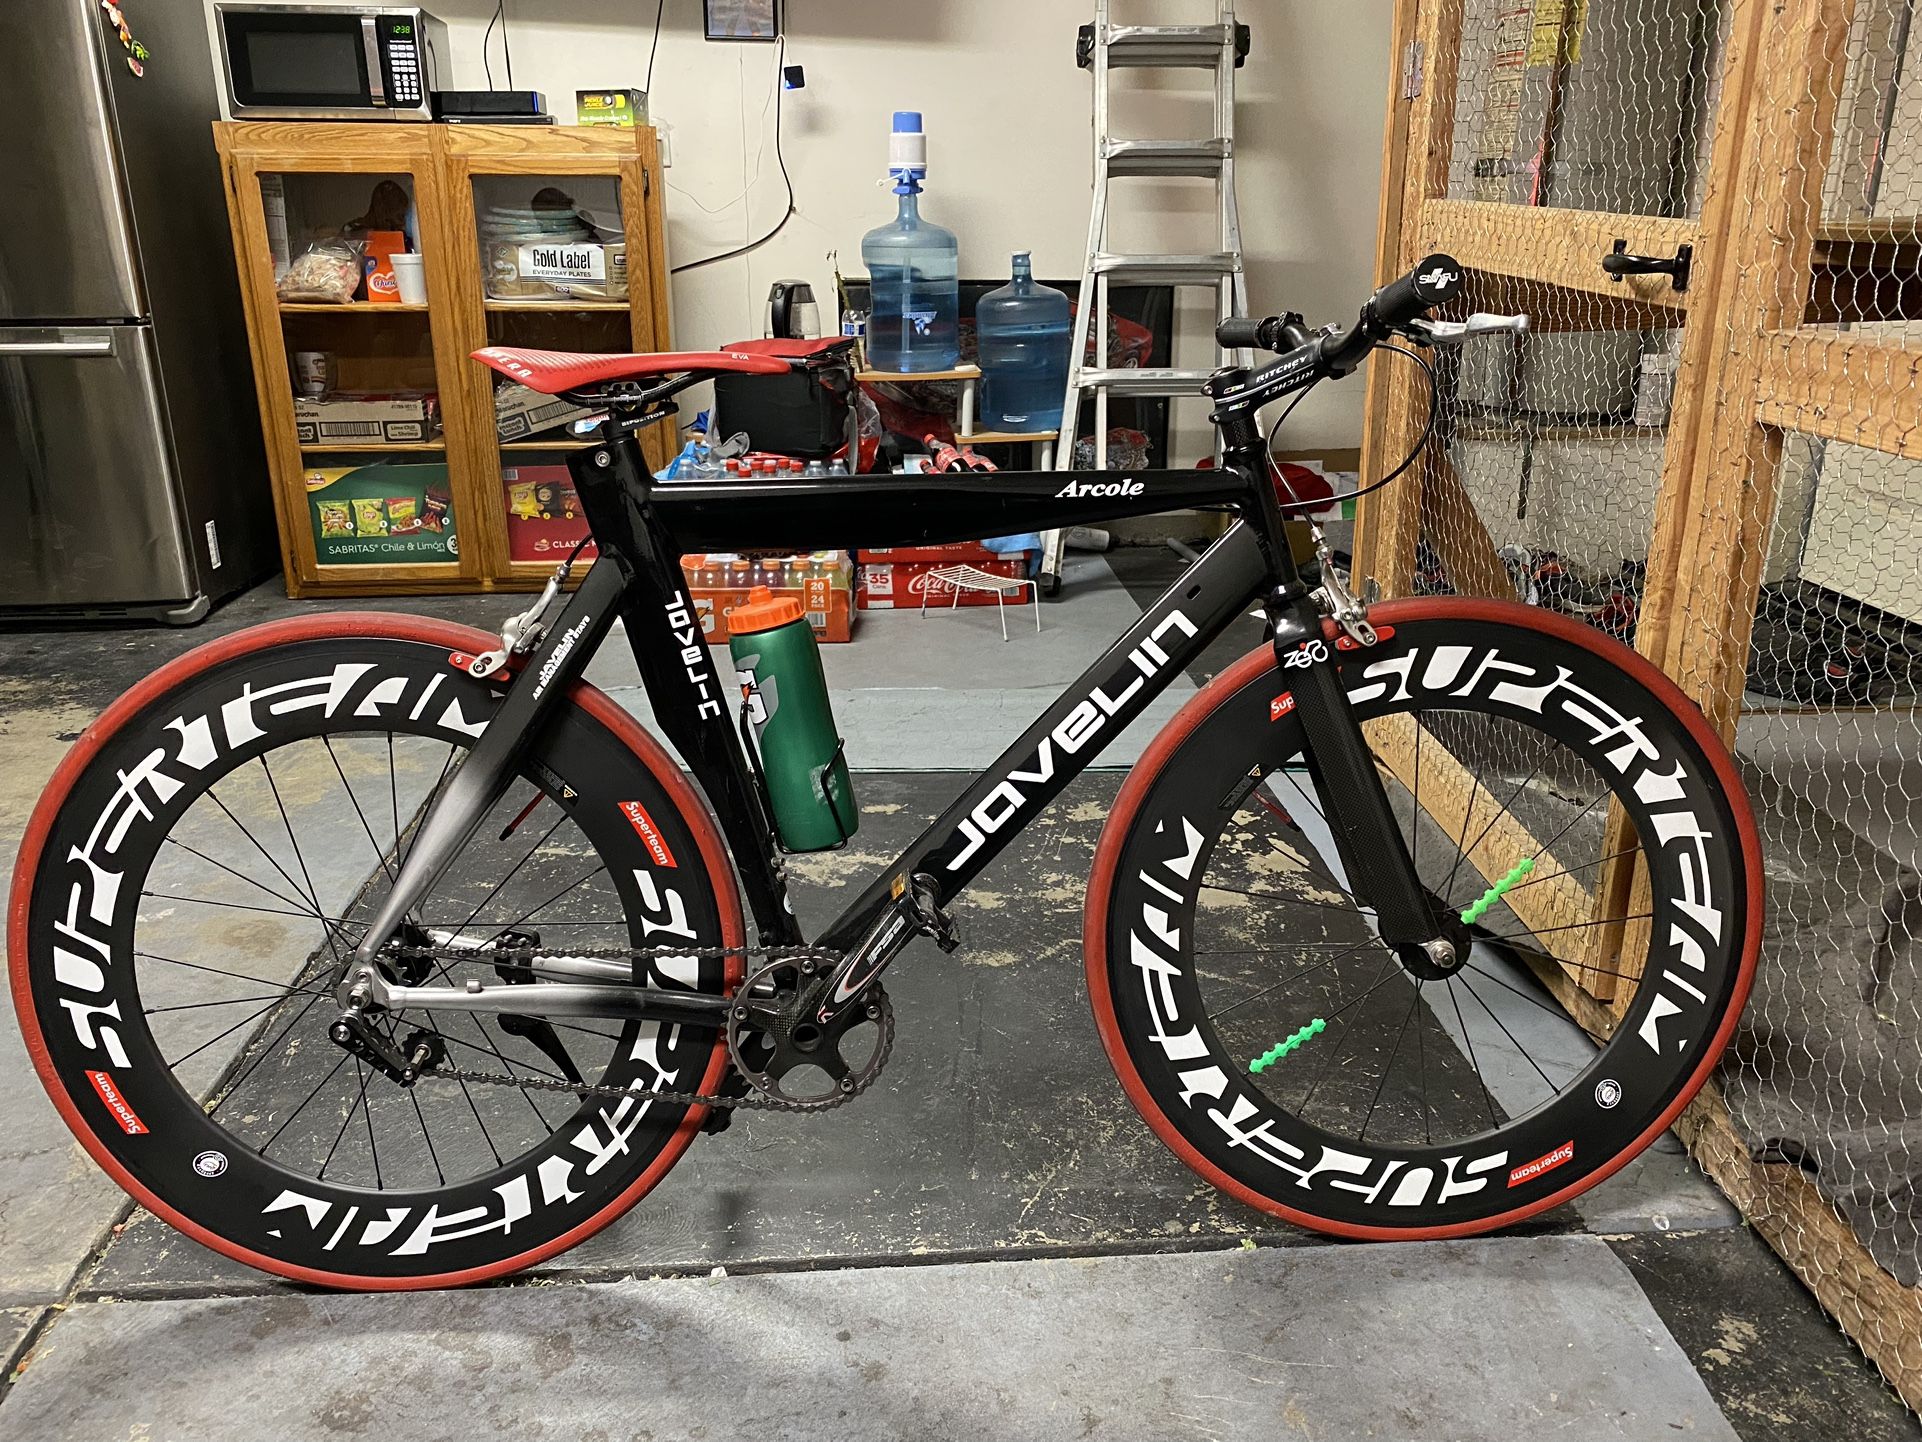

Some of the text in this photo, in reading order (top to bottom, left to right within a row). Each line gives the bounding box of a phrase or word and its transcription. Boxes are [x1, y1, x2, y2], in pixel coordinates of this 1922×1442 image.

[533, 249, 591, 269] Gold Label
[532, 269, 567, 277] EVERYDAY
[731, 353, 749, 361] EVA
[1256, 355, 1308, 383] RITCHEY
[1262, 370, 1314, 398] RITCHEY
[1055, 478, 1144, 498] Arcole
[381, 542, 405, 551] Chile
[416, 540, 445, 550] Limón
[810, 582, 825, 591] 20
[869, 574, 889, 584] 35
[810, 595, 825, 604] 24
[573, 615, 591, 639] STAYS
[539, 628, 575, 680] JAVELIN
[625, 801, 668, 865] Superteam
[95, 1073, 141, 1133] Superteam
[1511, 1147, 1573, 1181] Superteam
